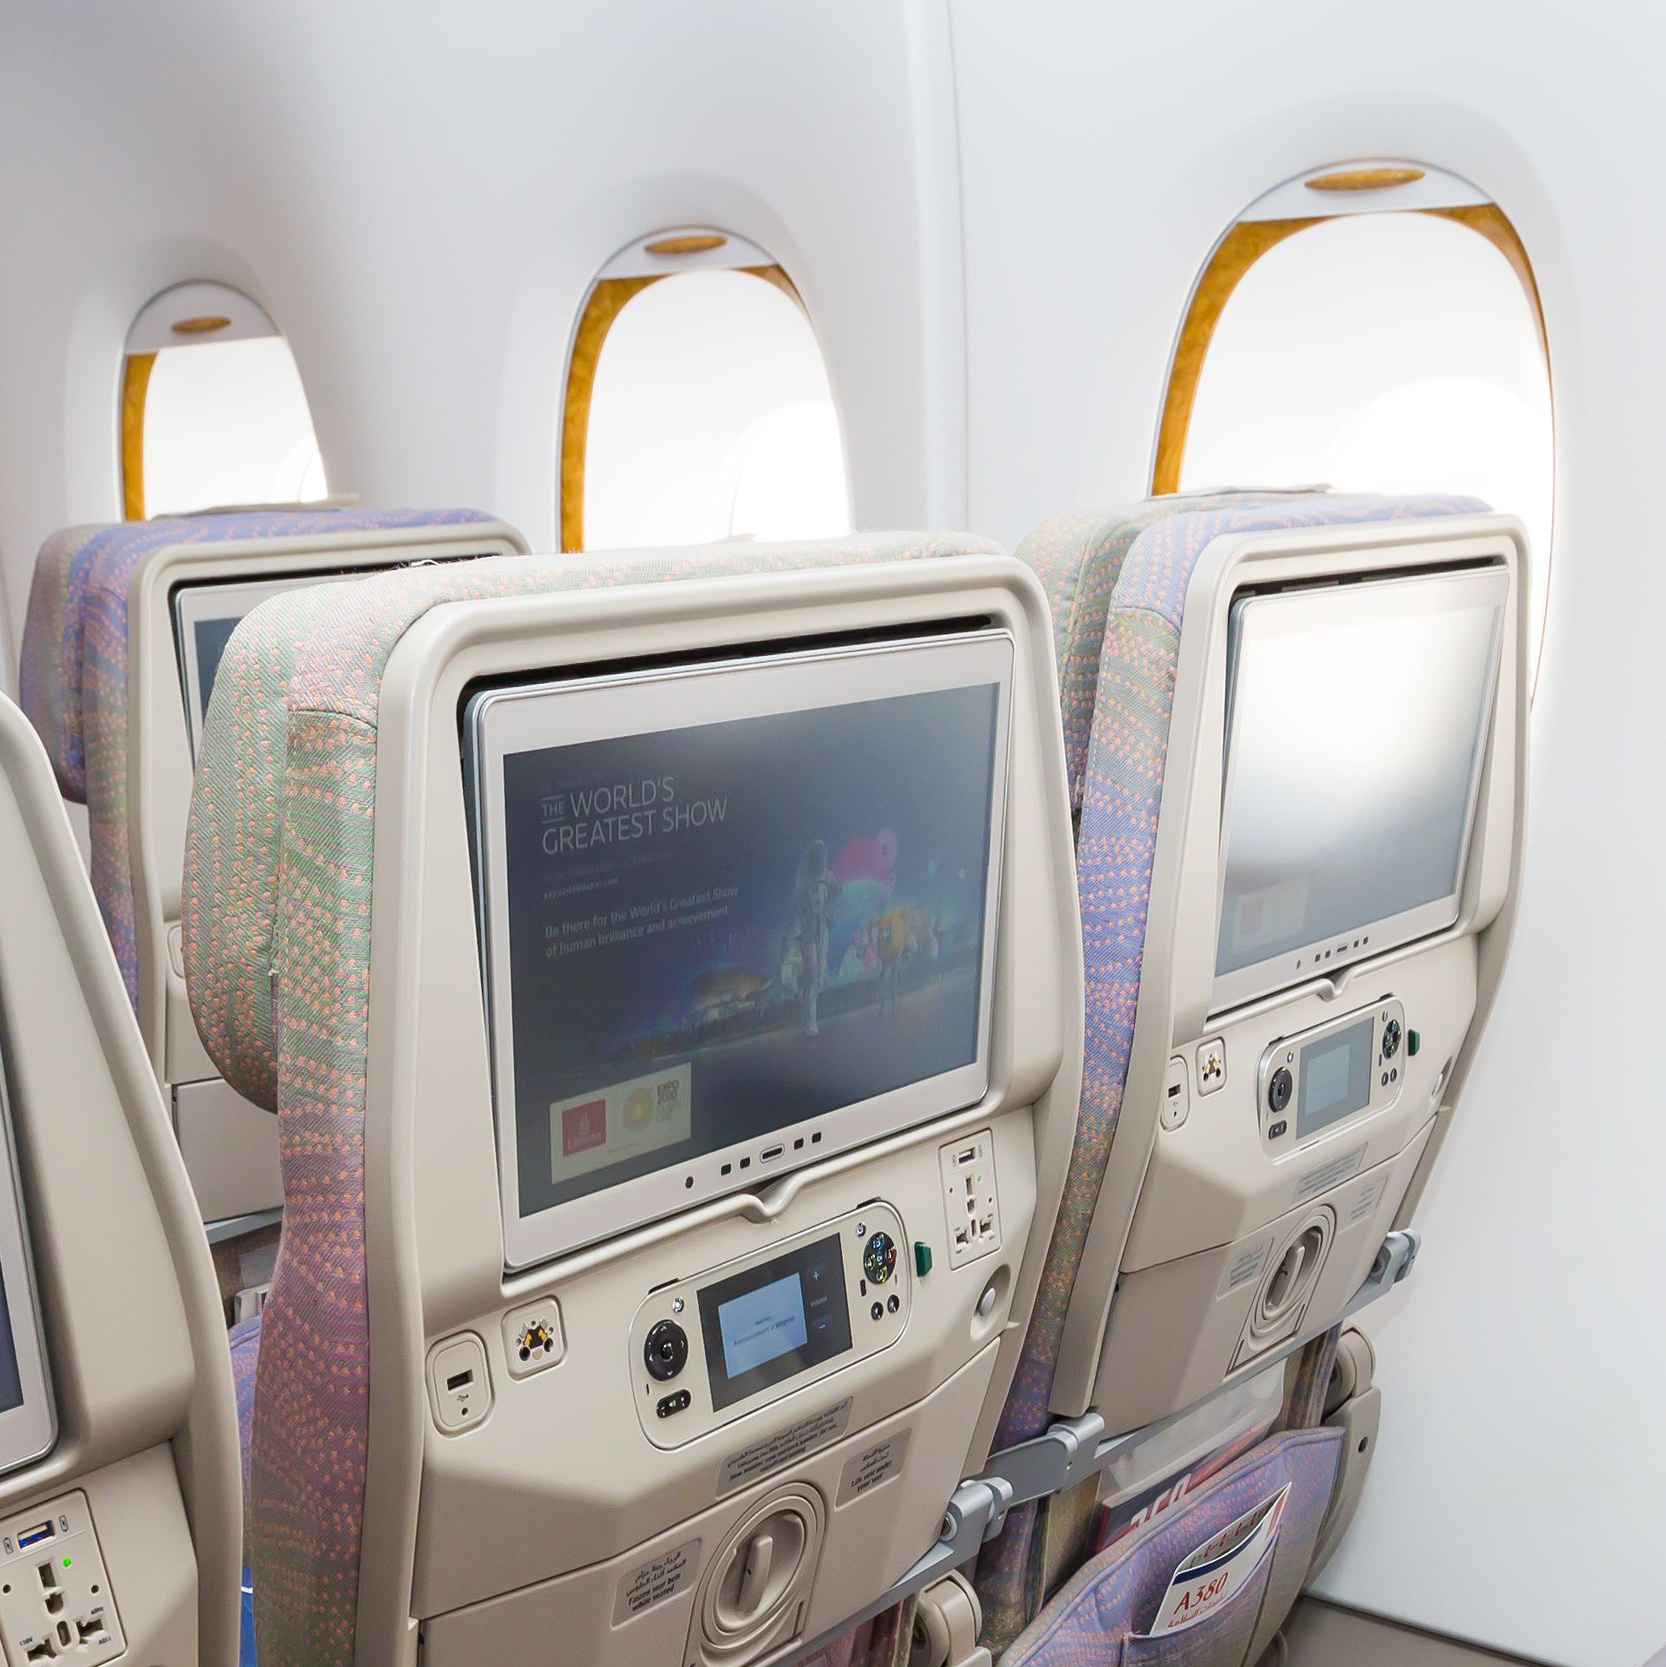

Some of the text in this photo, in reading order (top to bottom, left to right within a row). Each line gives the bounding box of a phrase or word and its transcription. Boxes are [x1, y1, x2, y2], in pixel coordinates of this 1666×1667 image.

[542, 801, 565, 817] THE
[570, 776, 675, 818] WORLD'S
[542, 796, 728, 854] GREATEST SHOW
[545, 924, 560, 939] Be
[562, 918, 590, 934] there
[593, 912, 608, 929] for
[610, 911, 628, 923] the
[713, 886, 739, 899] Show
[559, 936, 596, 955] human
[646, 920, 665, 934] and
[1173, 1571, 1229, 1616] A380
